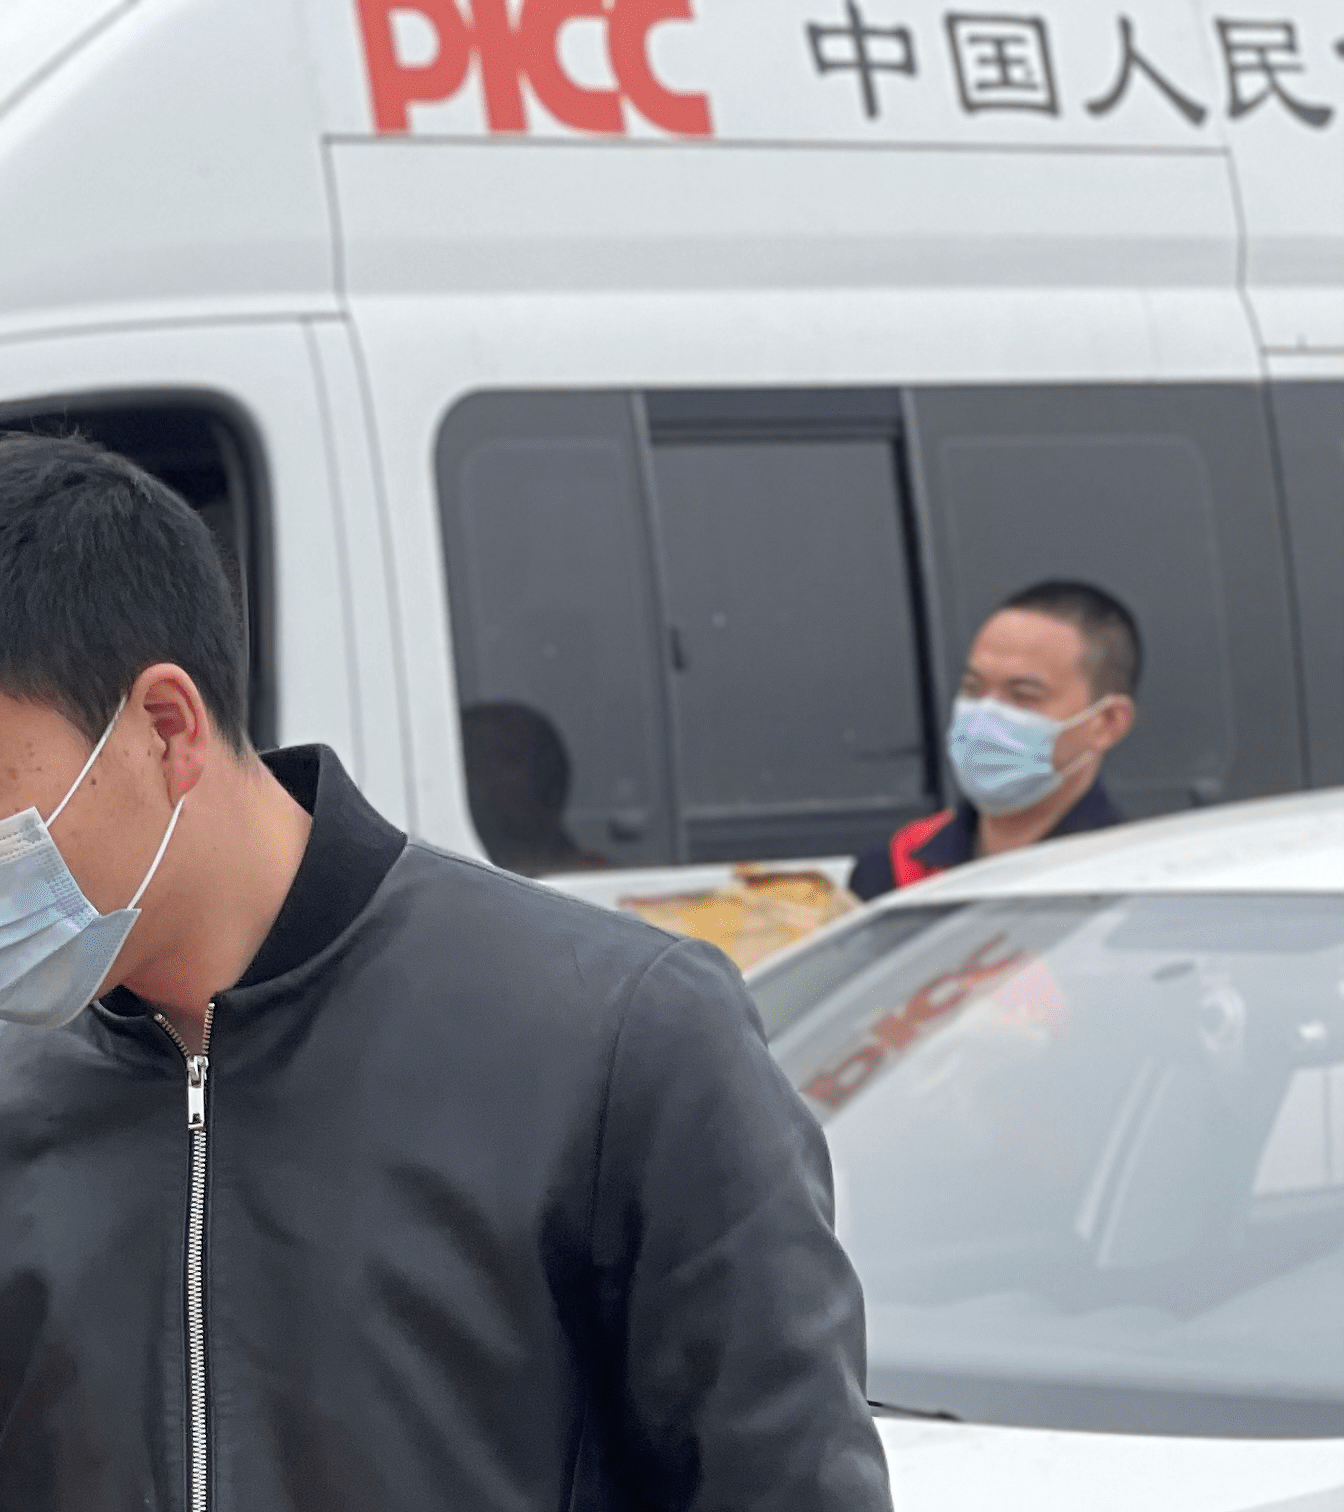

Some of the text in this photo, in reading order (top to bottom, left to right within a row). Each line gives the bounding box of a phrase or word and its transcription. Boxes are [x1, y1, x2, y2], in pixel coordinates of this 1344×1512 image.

[354, 0, 714, 138] PICC
[804, 0, 1344, 130] 中国人民
